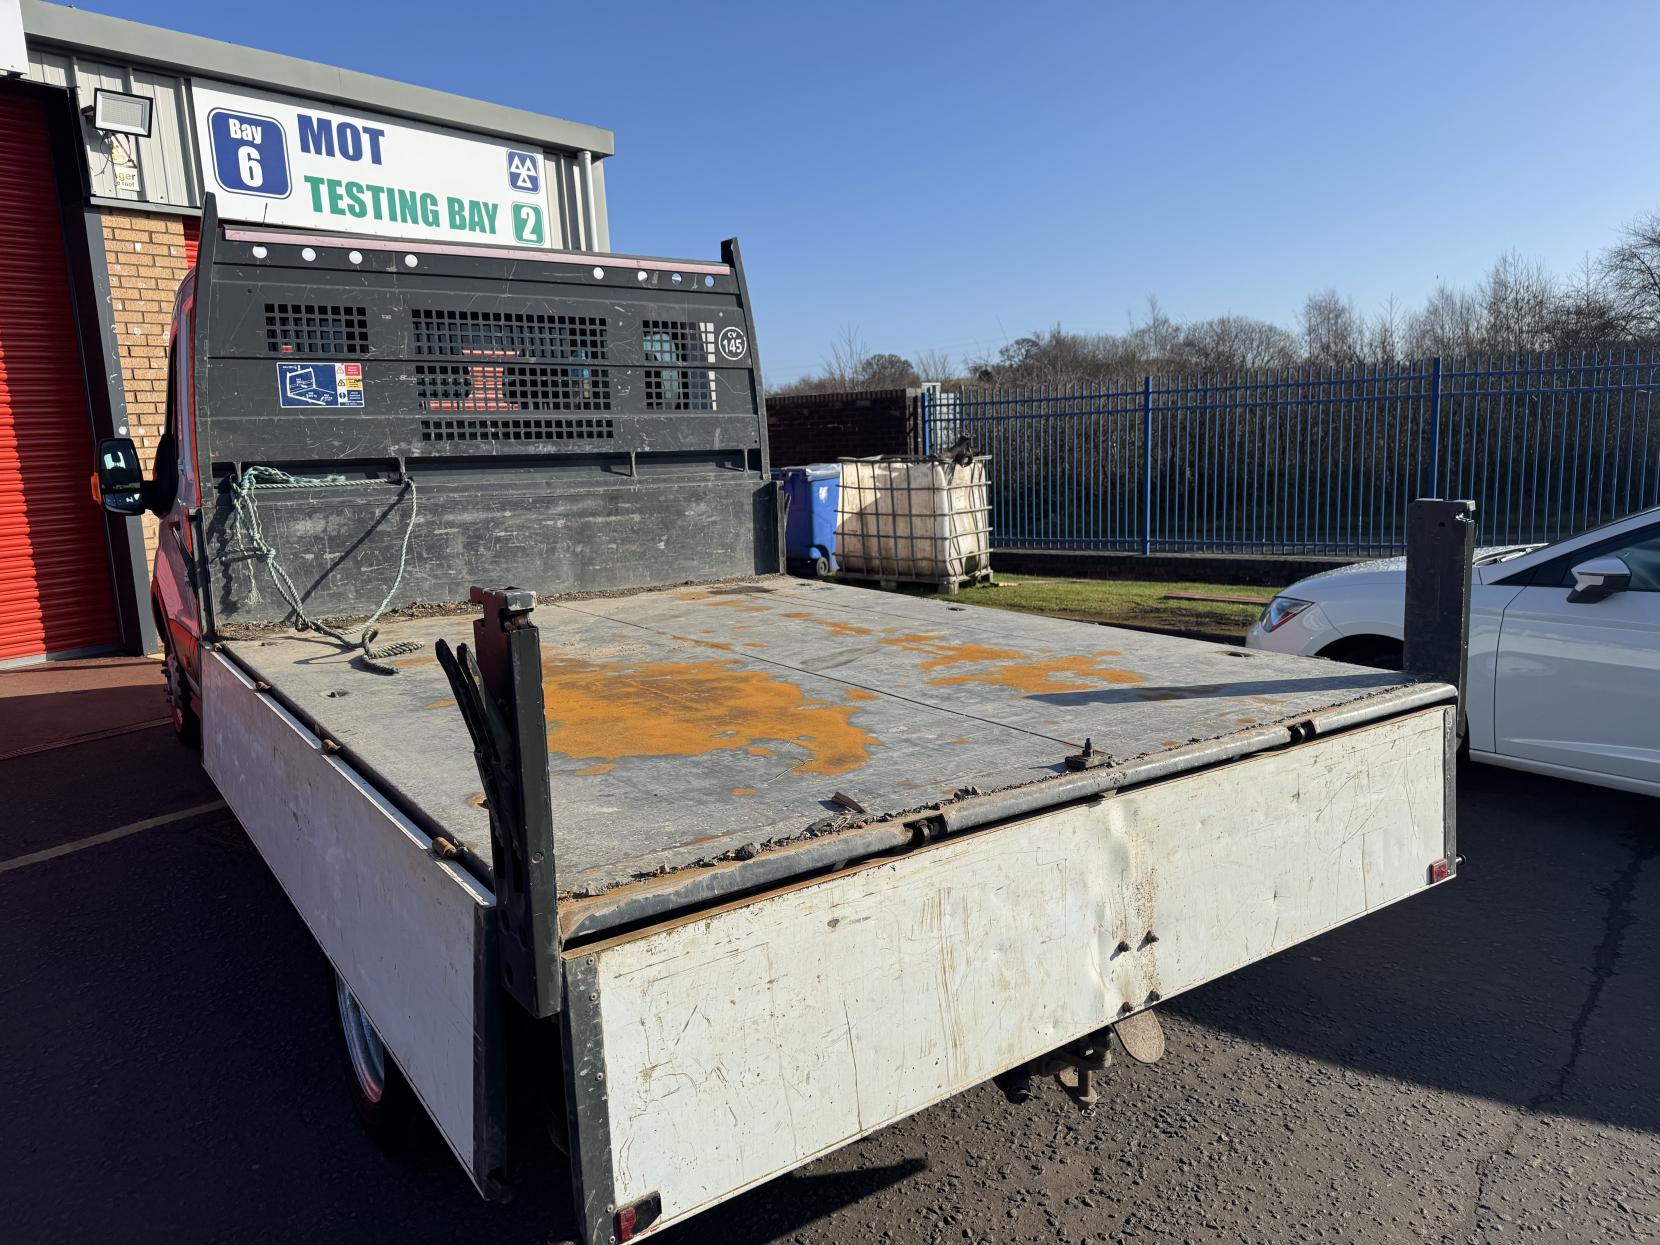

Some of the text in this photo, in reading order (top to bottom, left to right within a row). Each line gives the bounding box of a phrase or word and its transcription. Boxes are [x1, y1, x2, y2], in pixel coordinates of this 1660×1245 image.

[228, 118, 262, 144] Bay
[297, 114, 385, 165] MOT
[238, 146, 264, 187] 6
[304, 175, 498, 235] TESTING BAY
[520, 206, 538, 241] 2
[723, 339, 742, 353] 145
